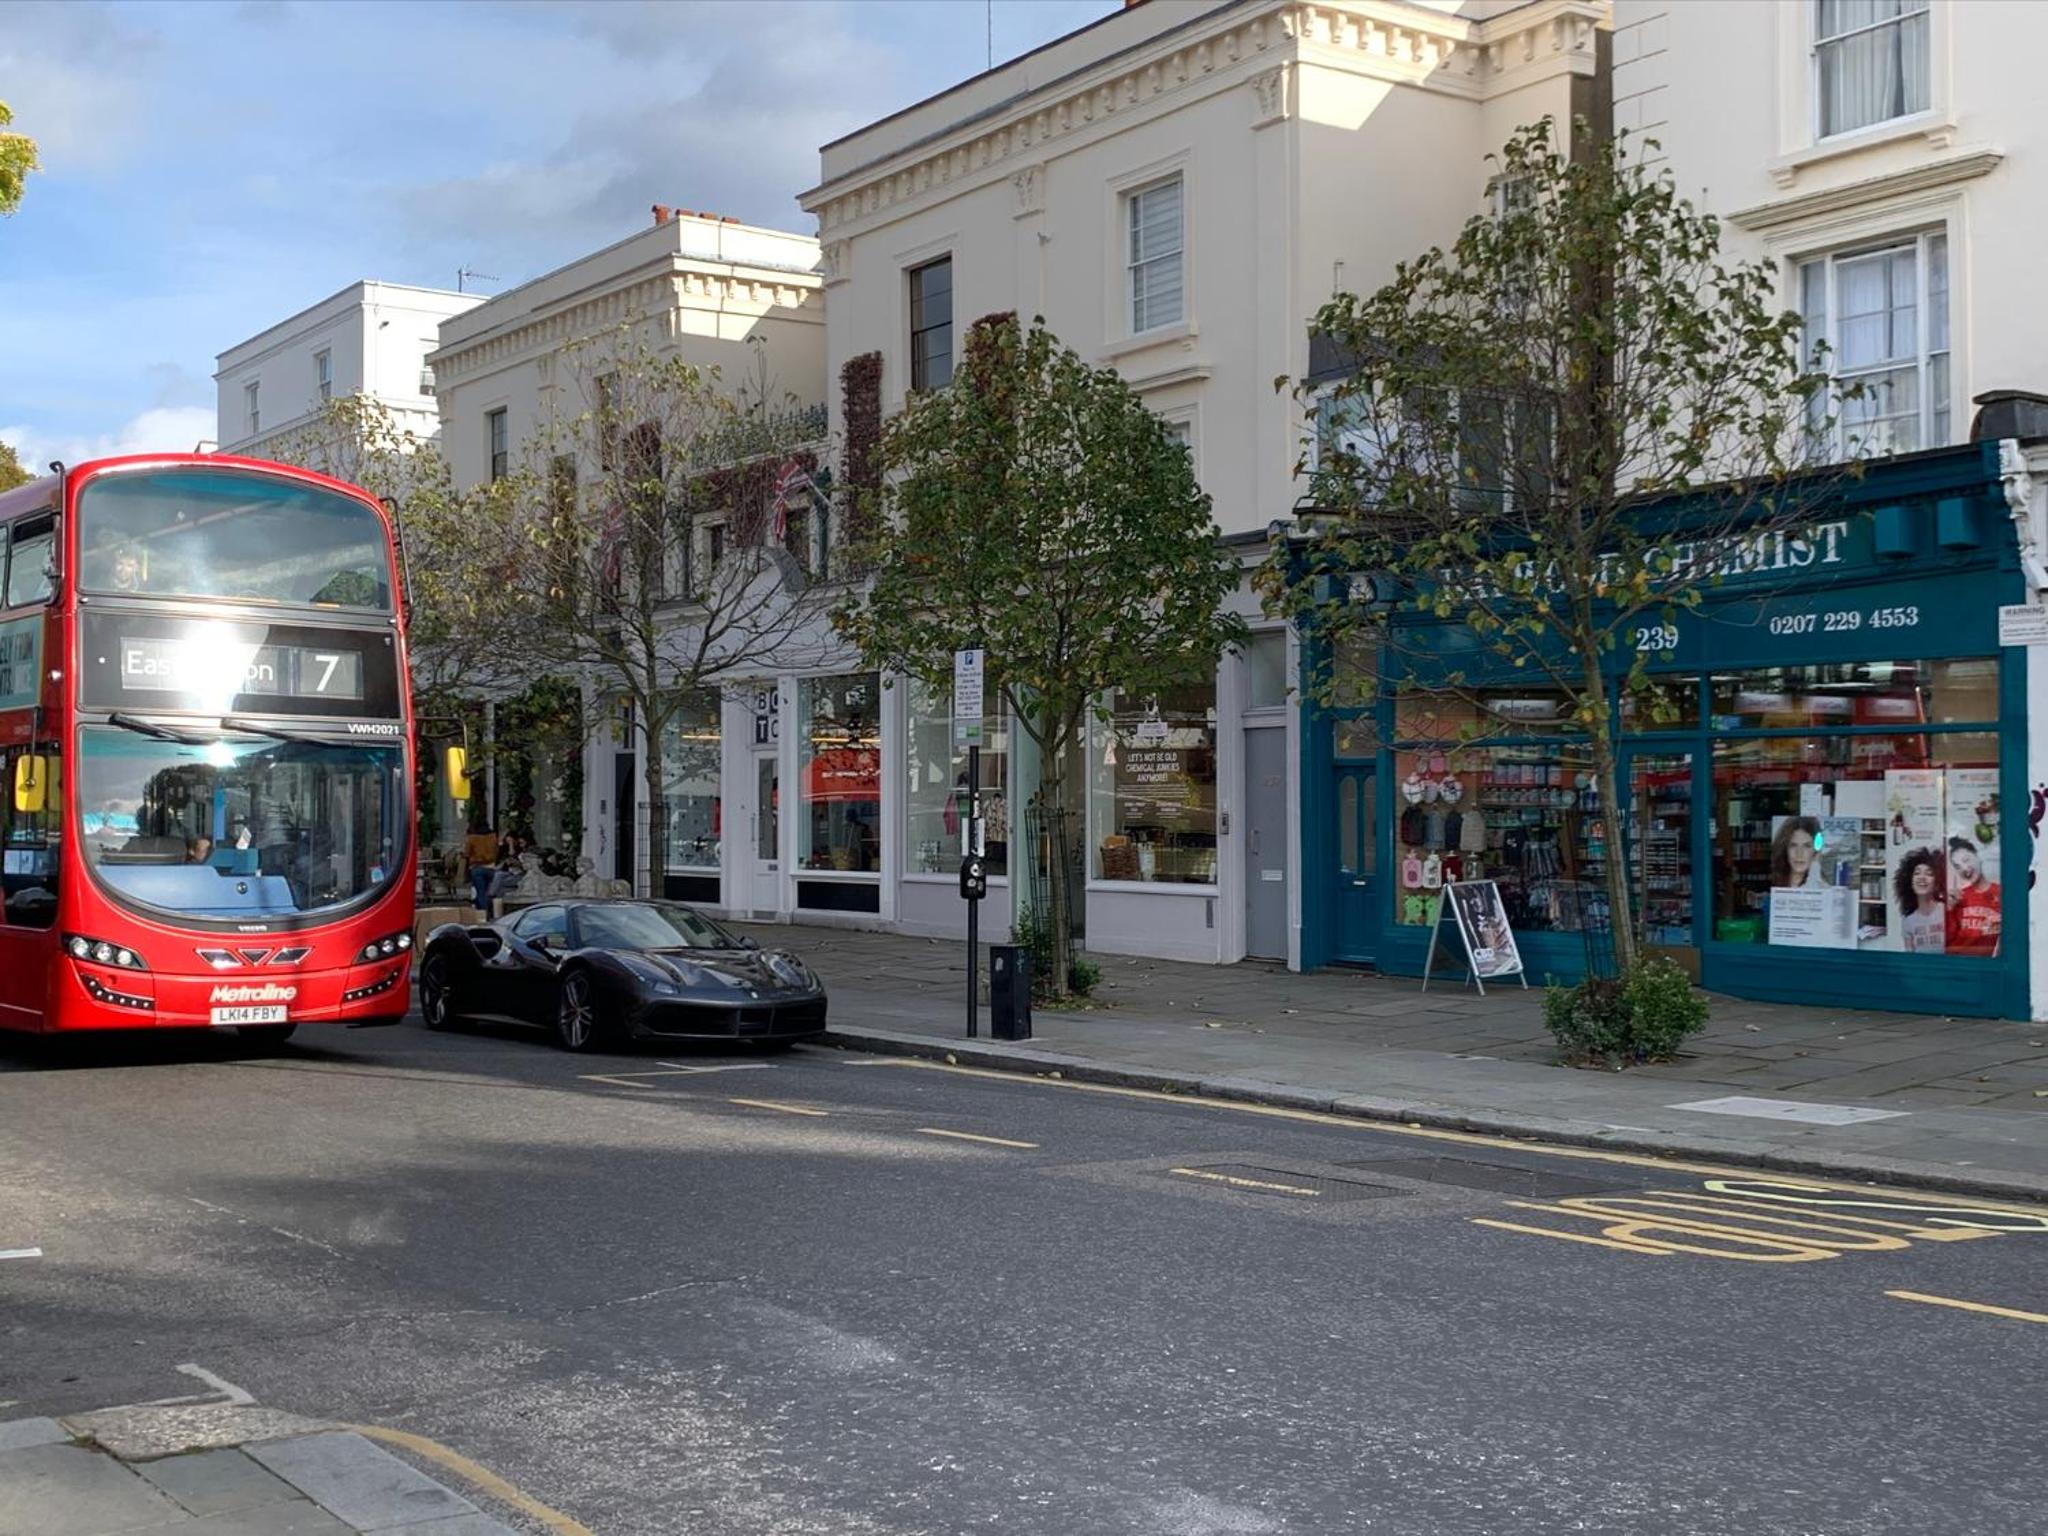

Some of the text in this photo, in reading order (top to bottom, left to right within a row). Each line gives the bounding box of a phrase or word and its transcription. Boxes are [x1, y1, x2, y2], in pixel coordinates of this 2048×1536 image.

[1769, 606, 1920, 635] 0207 229 4553
[1636, 626, 1679, 650] 239
[127, 649, 177, 676] Eas
[314, 654, 340, 692] 7
[347, 723, 400, 736] VWH2021
[1144, 752, 1156, 762] NOT
[1164, 751, 1178, 761] OLD
[1125, 762, 1180, 773] CHEMICAL JUNKIES
[208, 982, 298, 1003] Metroline
[219, 1006, 279, 1021] LK14 FBY
